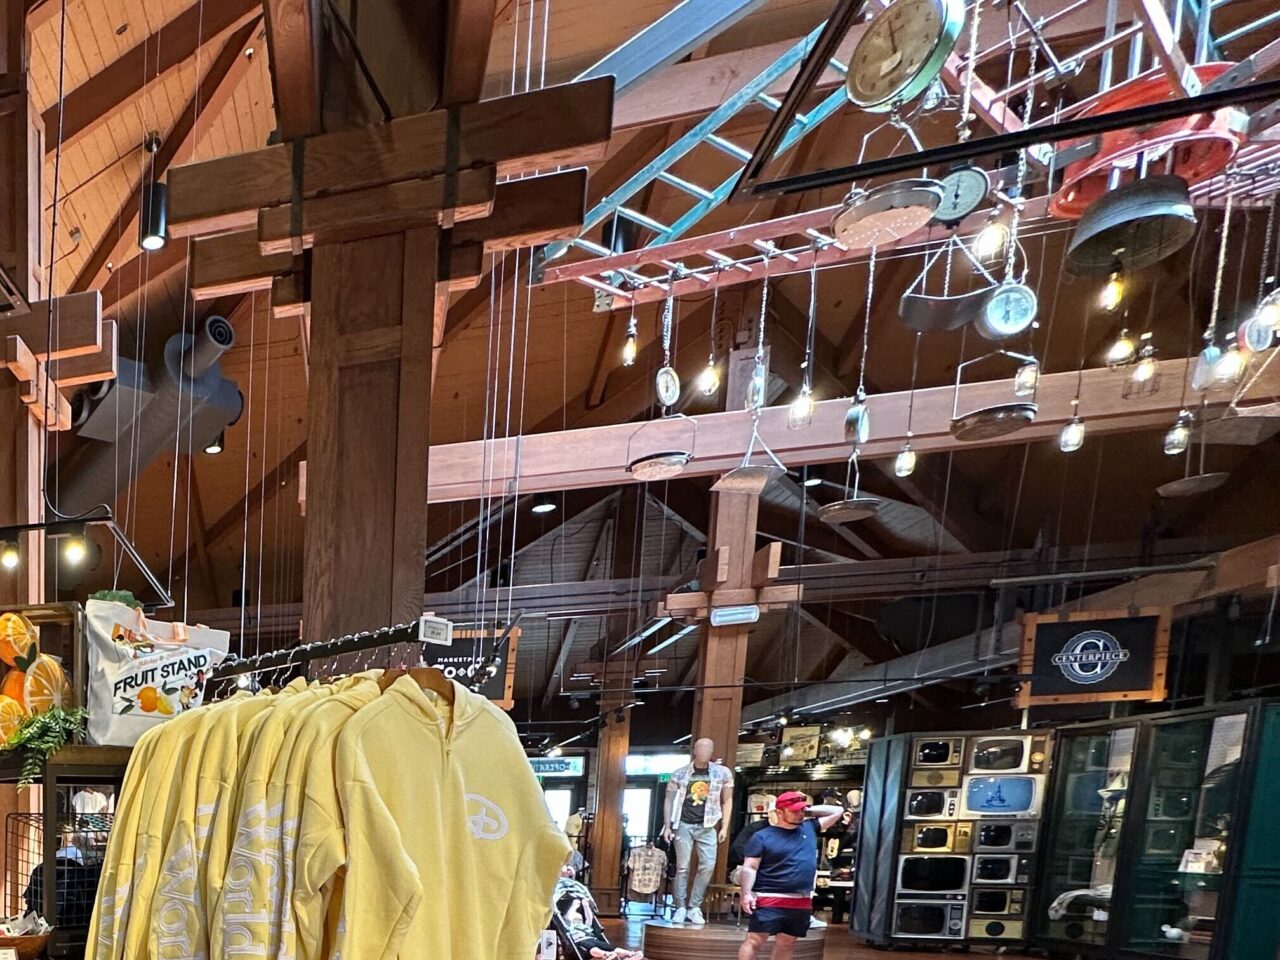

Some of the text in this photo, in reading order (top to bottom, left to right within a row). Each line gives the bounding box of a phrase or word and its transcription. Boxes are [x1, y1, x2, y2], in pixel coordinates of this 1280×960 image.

[113, 667, 158, 698] FRUIT
[160, 654, 207, 679] STAND
[1055, 652, 1125, 663] CENTERPIECE
[223, 798, 269, 958] World
